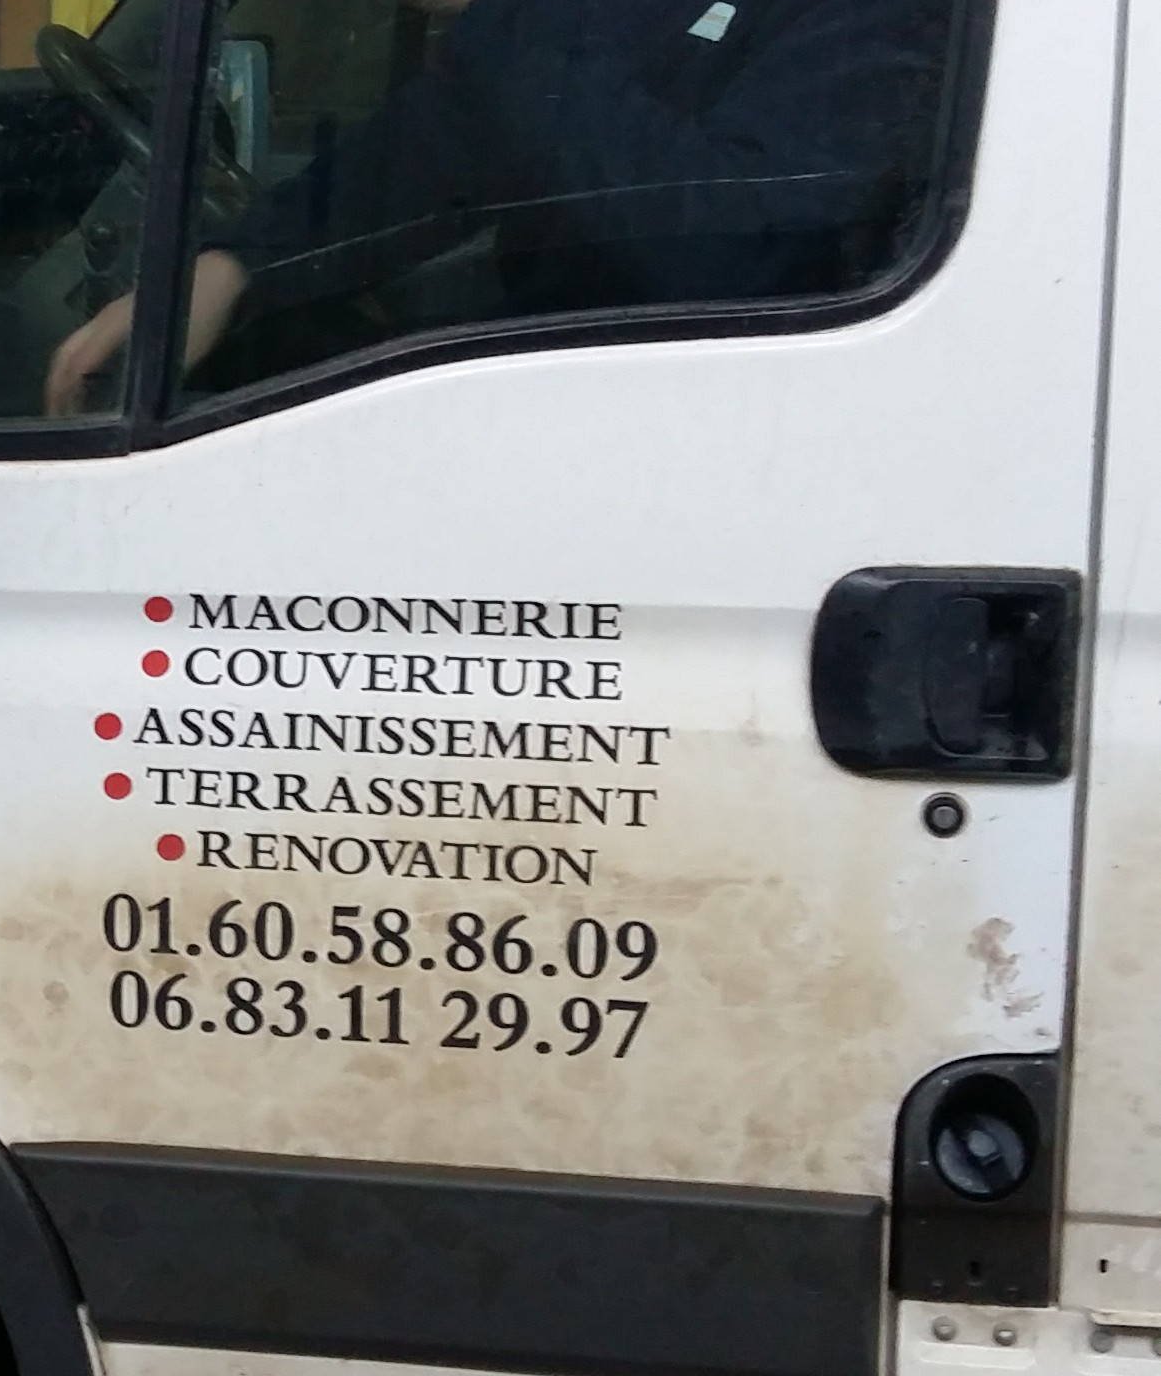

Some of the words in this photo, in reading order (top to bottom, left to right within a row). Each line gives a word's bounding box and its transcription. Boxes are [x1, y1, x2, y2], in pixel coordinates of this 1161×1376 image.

[188, 593, 623, 640] MACONNERIE
[184, 648, 623, 701] COUVERTURE
[133, 708, 671, 765] ASSAINISSEMENT
[146, 767, 657, 827] TERRASSEMENT
[197, 831, 598, 885] RENOVATION
[102, 893, 659, 980] 01.60.58.86.09
